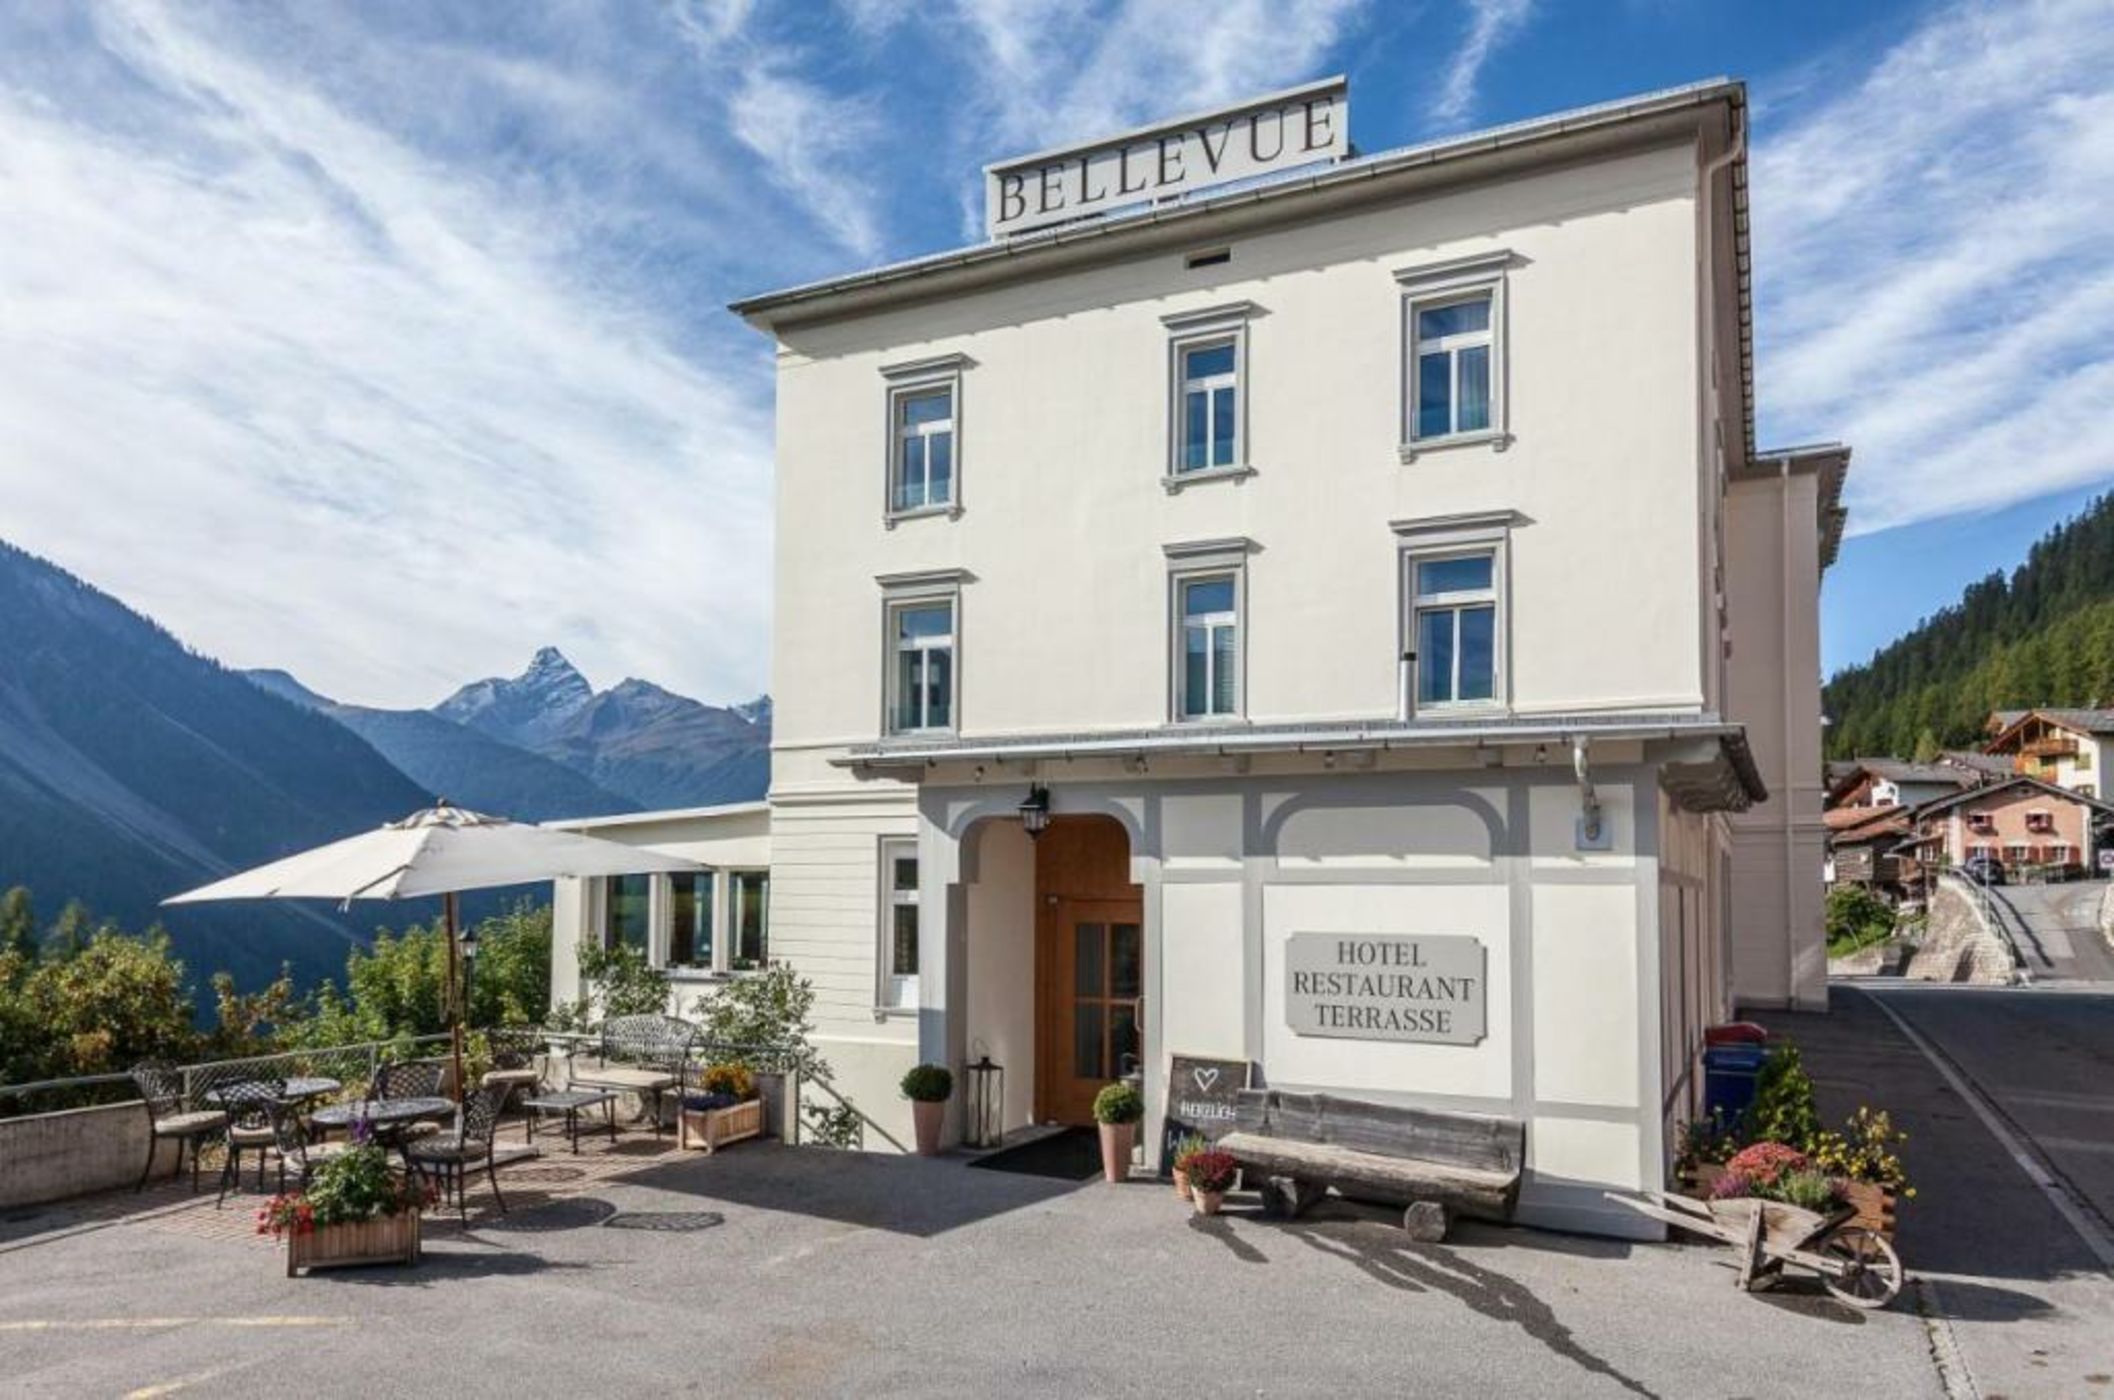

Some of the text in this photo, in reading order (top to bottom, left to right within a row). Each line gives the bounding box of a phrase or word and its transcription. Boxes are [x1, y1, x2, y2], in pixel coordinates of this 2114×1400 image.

[996, 97, 1335, 223] BELLEVUE
[1337, 941, 1427, 967] HOTEL
[1293, 971, 1475, 1002] RESTAURANT
[1314, 1003, 1452, 1033] TERRASSE
